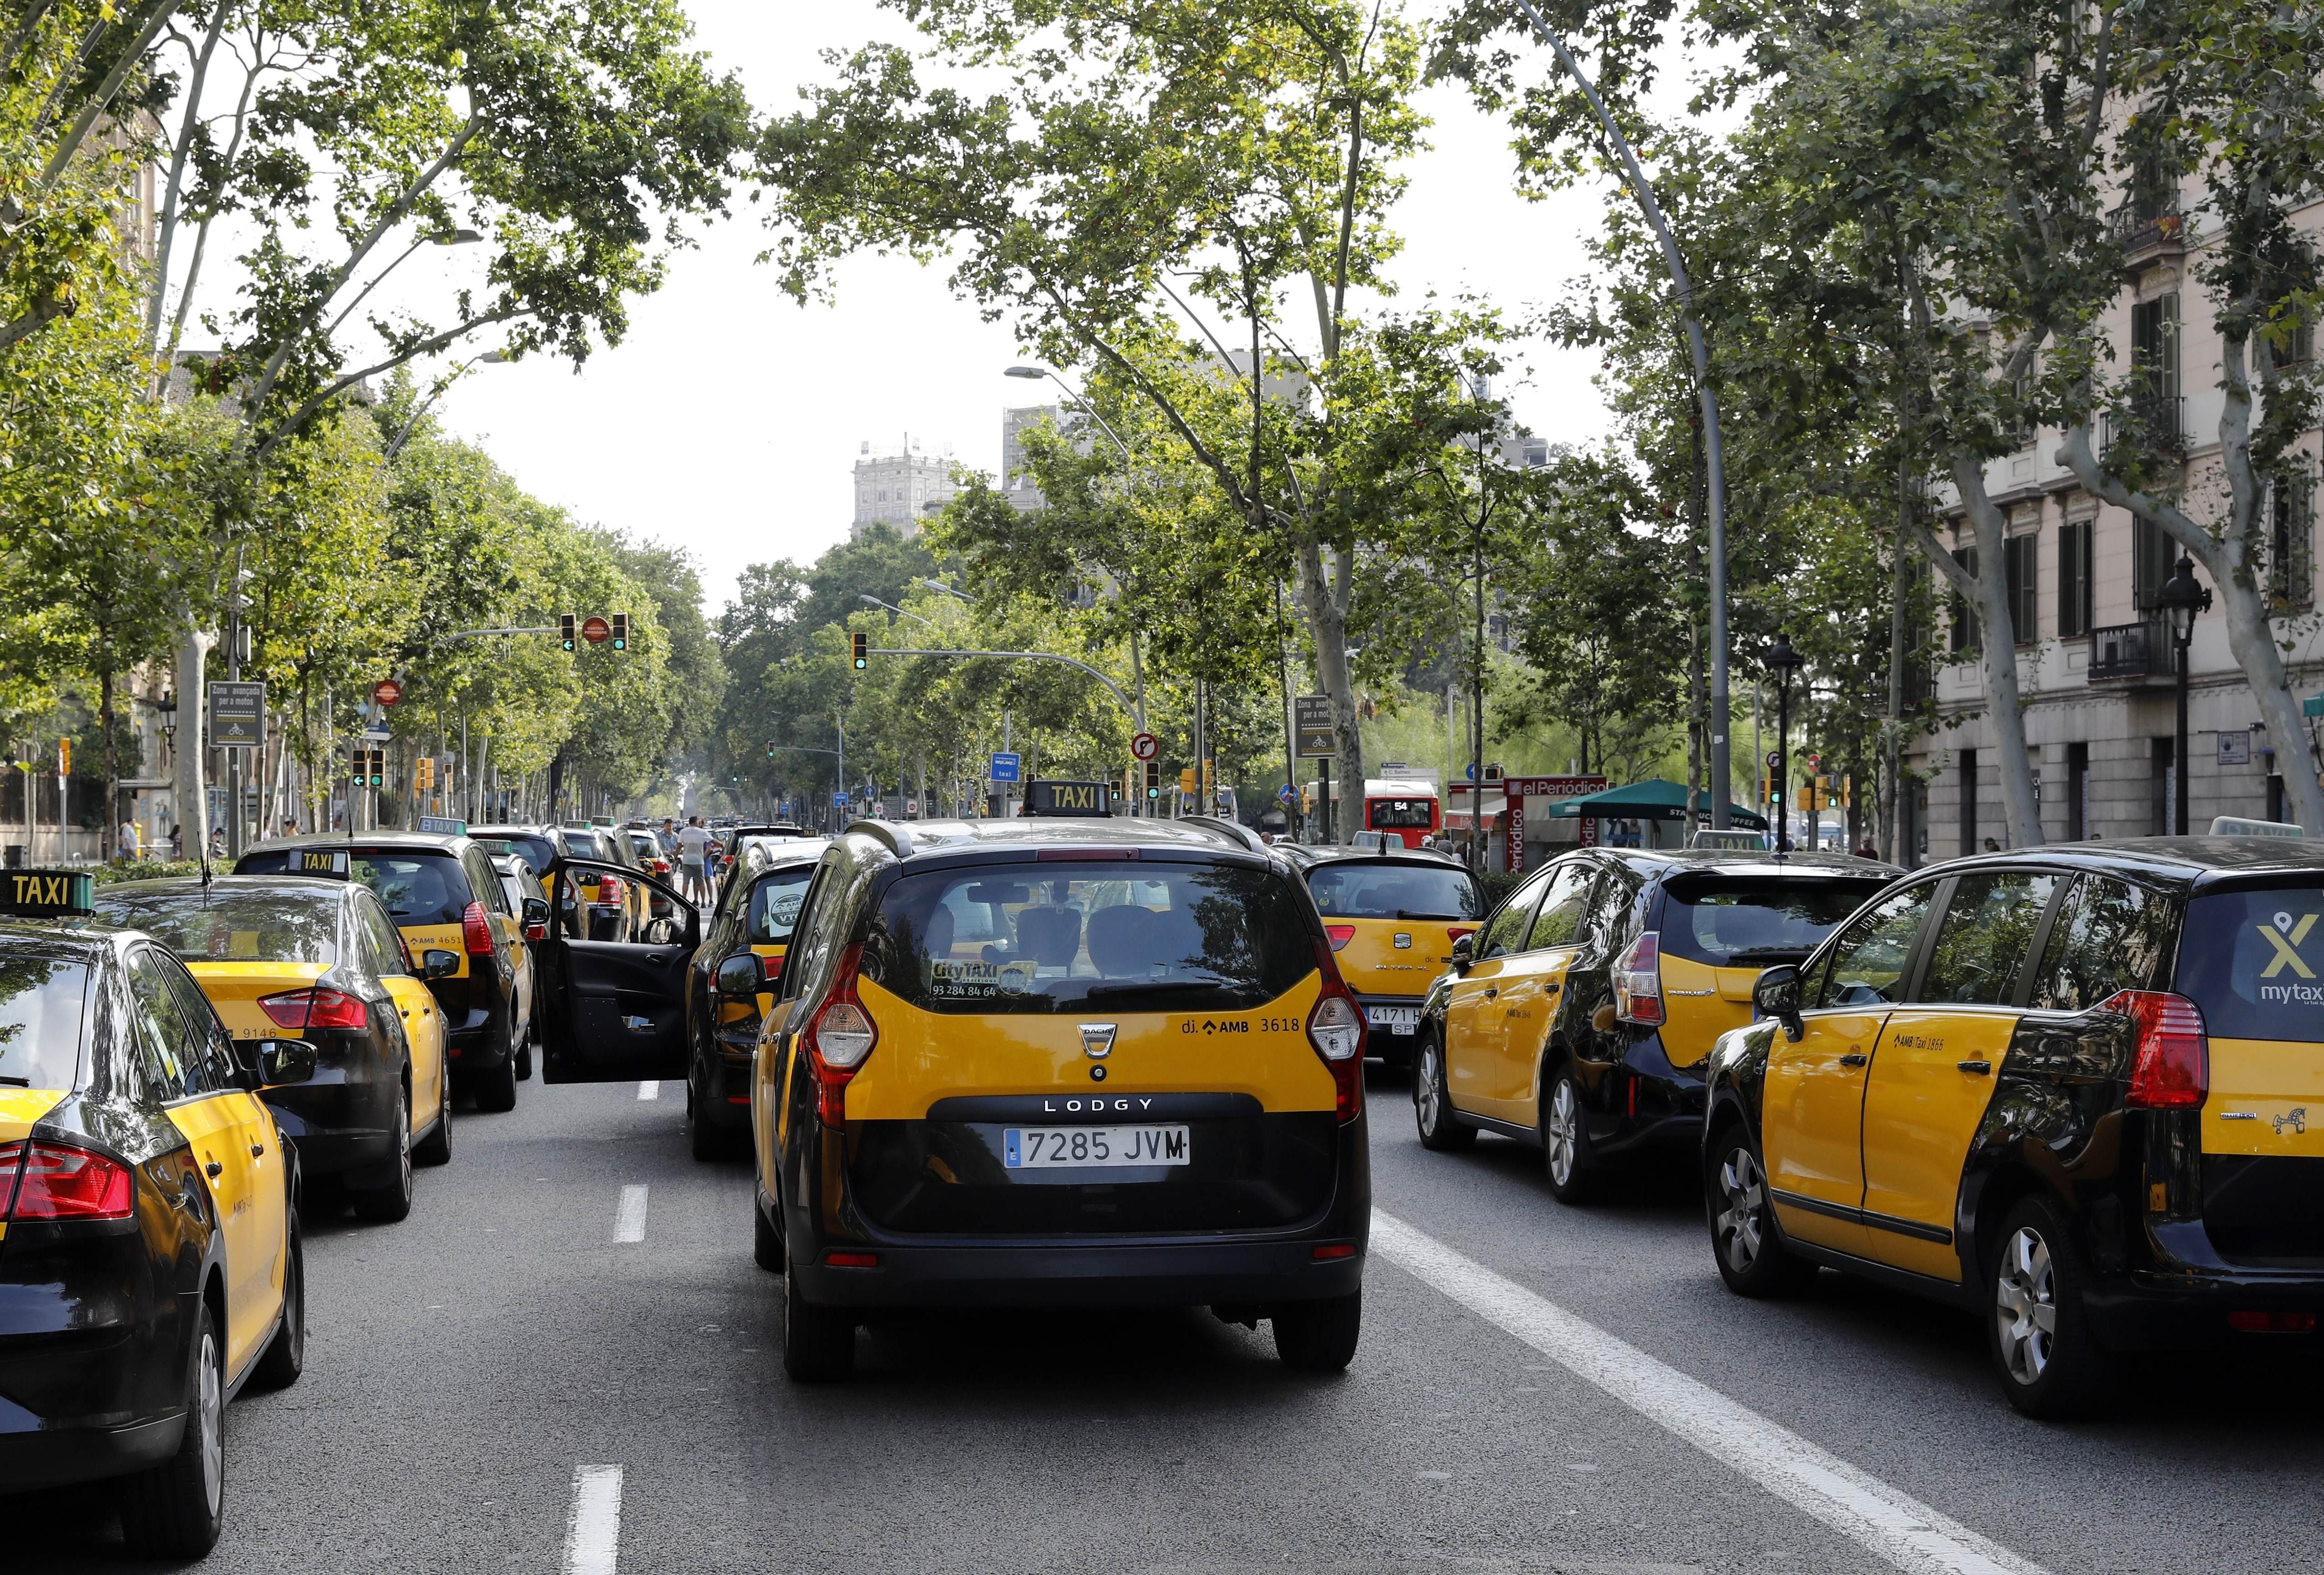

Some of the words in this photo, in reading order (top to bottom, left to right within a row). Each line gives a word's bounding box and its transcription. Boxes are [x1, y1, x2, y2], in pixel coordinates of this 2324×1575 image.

[212, 685, 227, 694] Zona
[232, 687, 260, 697] avançada
[1297, 700, 1311, 708] Zona
[1303, 712, 1312, 720] per
[1523, 782, 1536, 795] el
[1538, 780, 1605, 795] Periódico
[1051, 785, 1094, 808] TAXI
[1394, 802, 1407, 811] 54
[434, 820, 455, 833] TAXI
[486, 841, 503, 851] TAXI
[1719, 838, 1750, 850] TAXI
[304, 853, 332, 870] TAXI
[13, 876, 68, 905] TAXI
[933, 985, 944, 995] 93
[947, 986, 965, 995] 284
[968, 986, 981, 996] 84
[983, 987, 997, 997] 64
[2261, 983, 2324, 1004] mytax
[1372, 1009, 1406, 1021] 4171
[1219, 1021, 1249, 1033] AMB
[1261, 1018, 1299, 1032] 3618
[1394, 1025, 1412, 1034] SP
[243, 1028, 277, 1038] 9146
[1900, 1035, 1914, 1048] AMB
[1915, 1037, 1927, 1048] Taxi
[1927, 1038, 1944, 1051] 1866
[1044, 1099, 1153, 1112] LODGY
[1010, 1152, 1017, 1160] E
[1028, 1132, 1110, 1161] 7285
[1124, 1131, 1183, 1160] JVM
